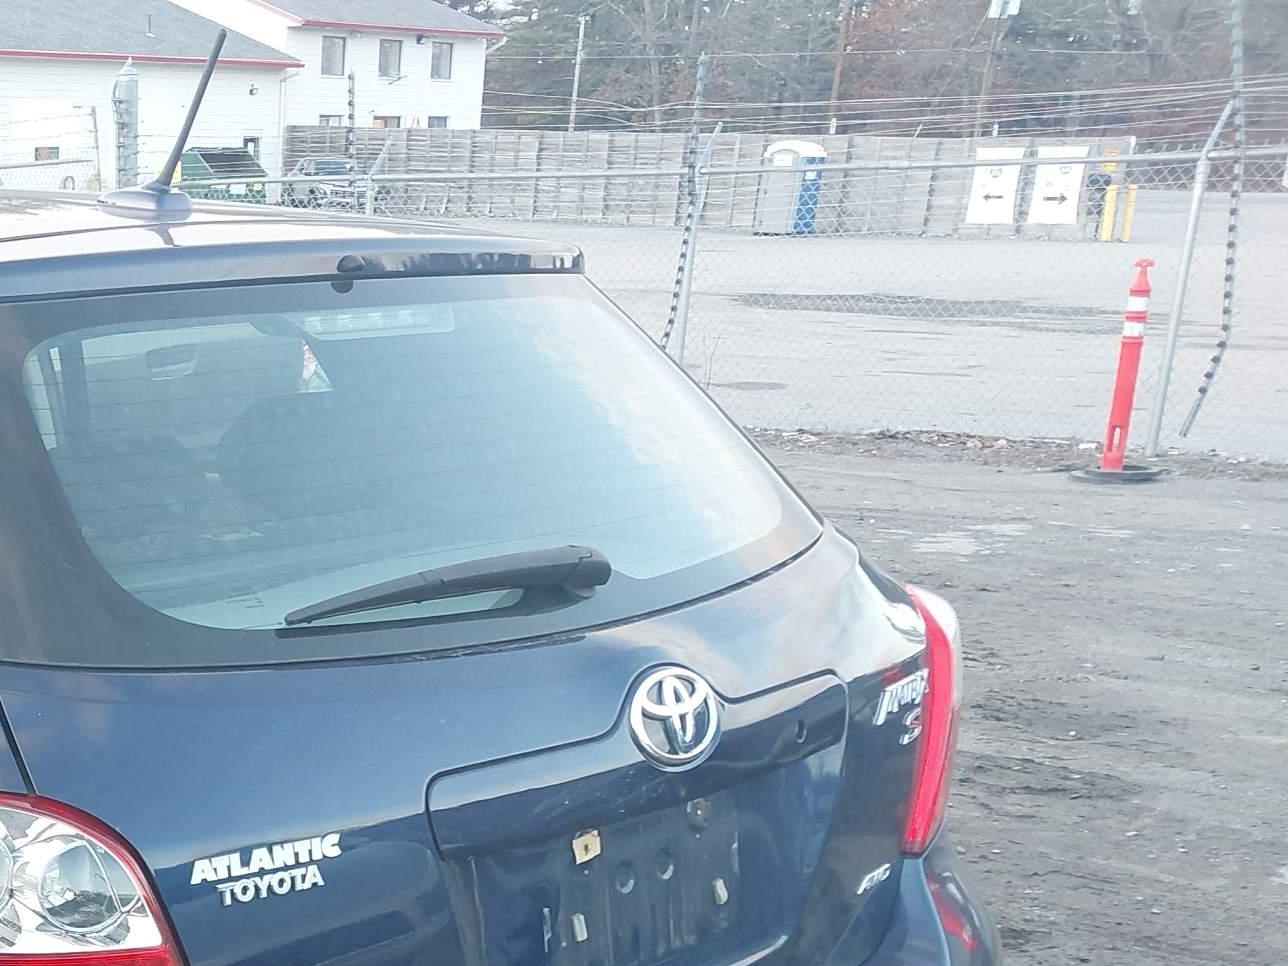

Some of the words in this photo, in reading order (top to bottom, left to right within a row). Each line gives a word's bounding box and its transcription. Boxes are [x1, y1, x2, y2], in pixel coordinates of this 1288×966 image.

[898, 707, 922, 746] S
[190, 832, 343, 885] ATLANTIC
[215, 863, 326, 907] TOYOTA
